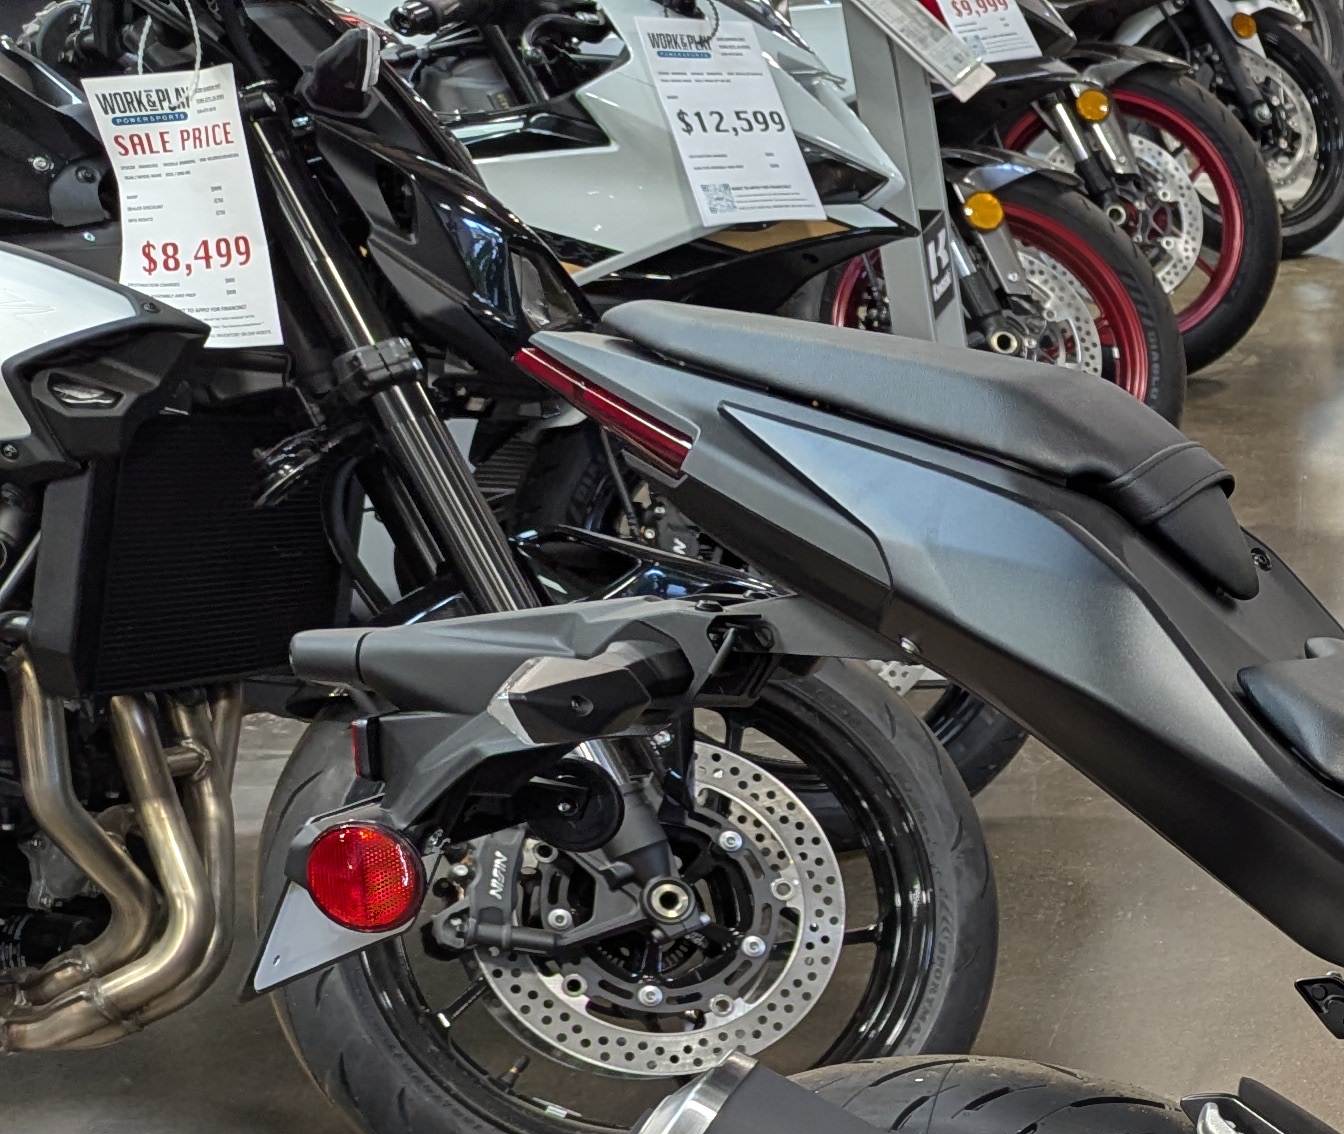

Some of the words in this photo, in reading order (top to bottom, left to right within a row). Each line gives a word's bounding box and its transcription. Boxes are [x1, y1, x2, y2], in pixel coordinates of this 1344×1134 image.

[115, 113, 185, 124] POWERSPORTS
[676, 108, 786, 136] $12,599
[113, 131, 173, 157] SALE
[179, 122, 235, 151] PRICE
[141, 235, 251, 277] $8,499
